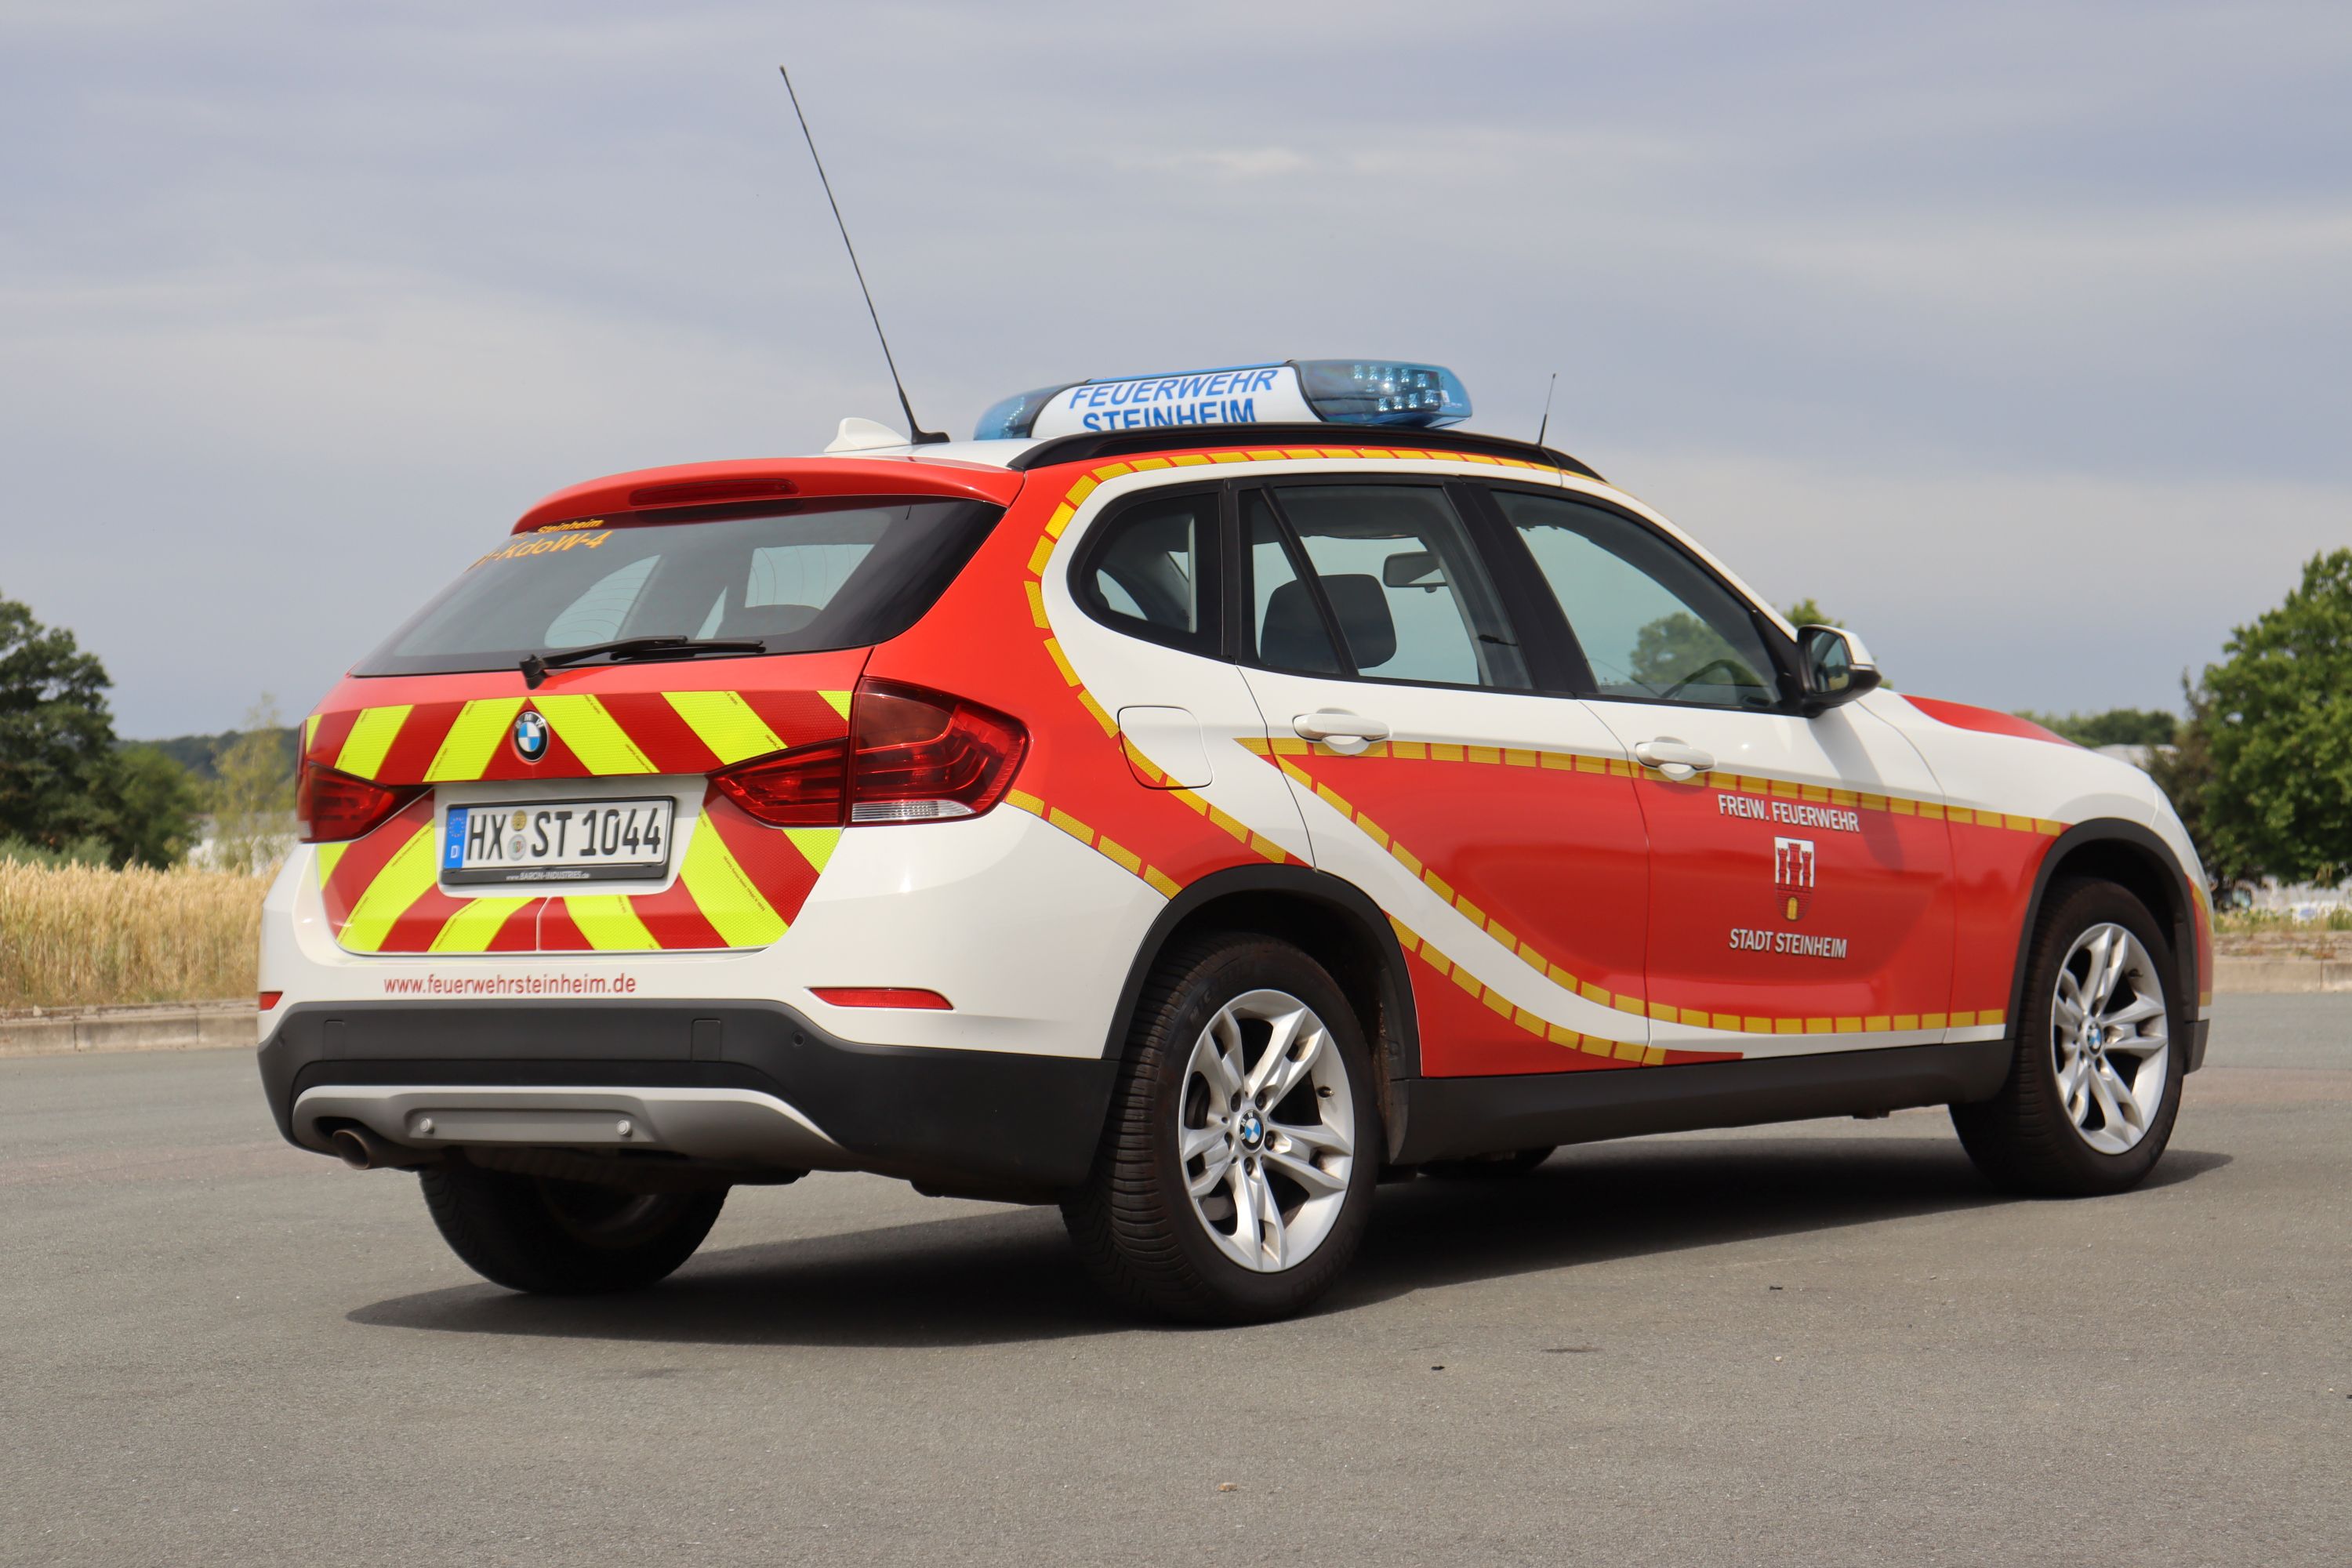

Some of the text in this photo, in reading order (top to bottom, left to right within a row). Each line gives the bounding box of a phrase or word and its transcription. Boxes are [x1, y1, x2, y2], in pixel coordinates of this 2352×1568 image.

[1068, 369, 1278, 409] FEUERWEHR
[1083, 398, 1256, 431] STEINHEIM
[1718, 794, 1860, 832] FREIW. FEUERWEHR
[466, 808, 661, 861] HX ST 1044
[449, 845, 460, 859] D
[1730, 928, 1847, 958] STADT STEINHEIM
[384, 973, 636, 994] www.feuerwehrsteinheim.de
